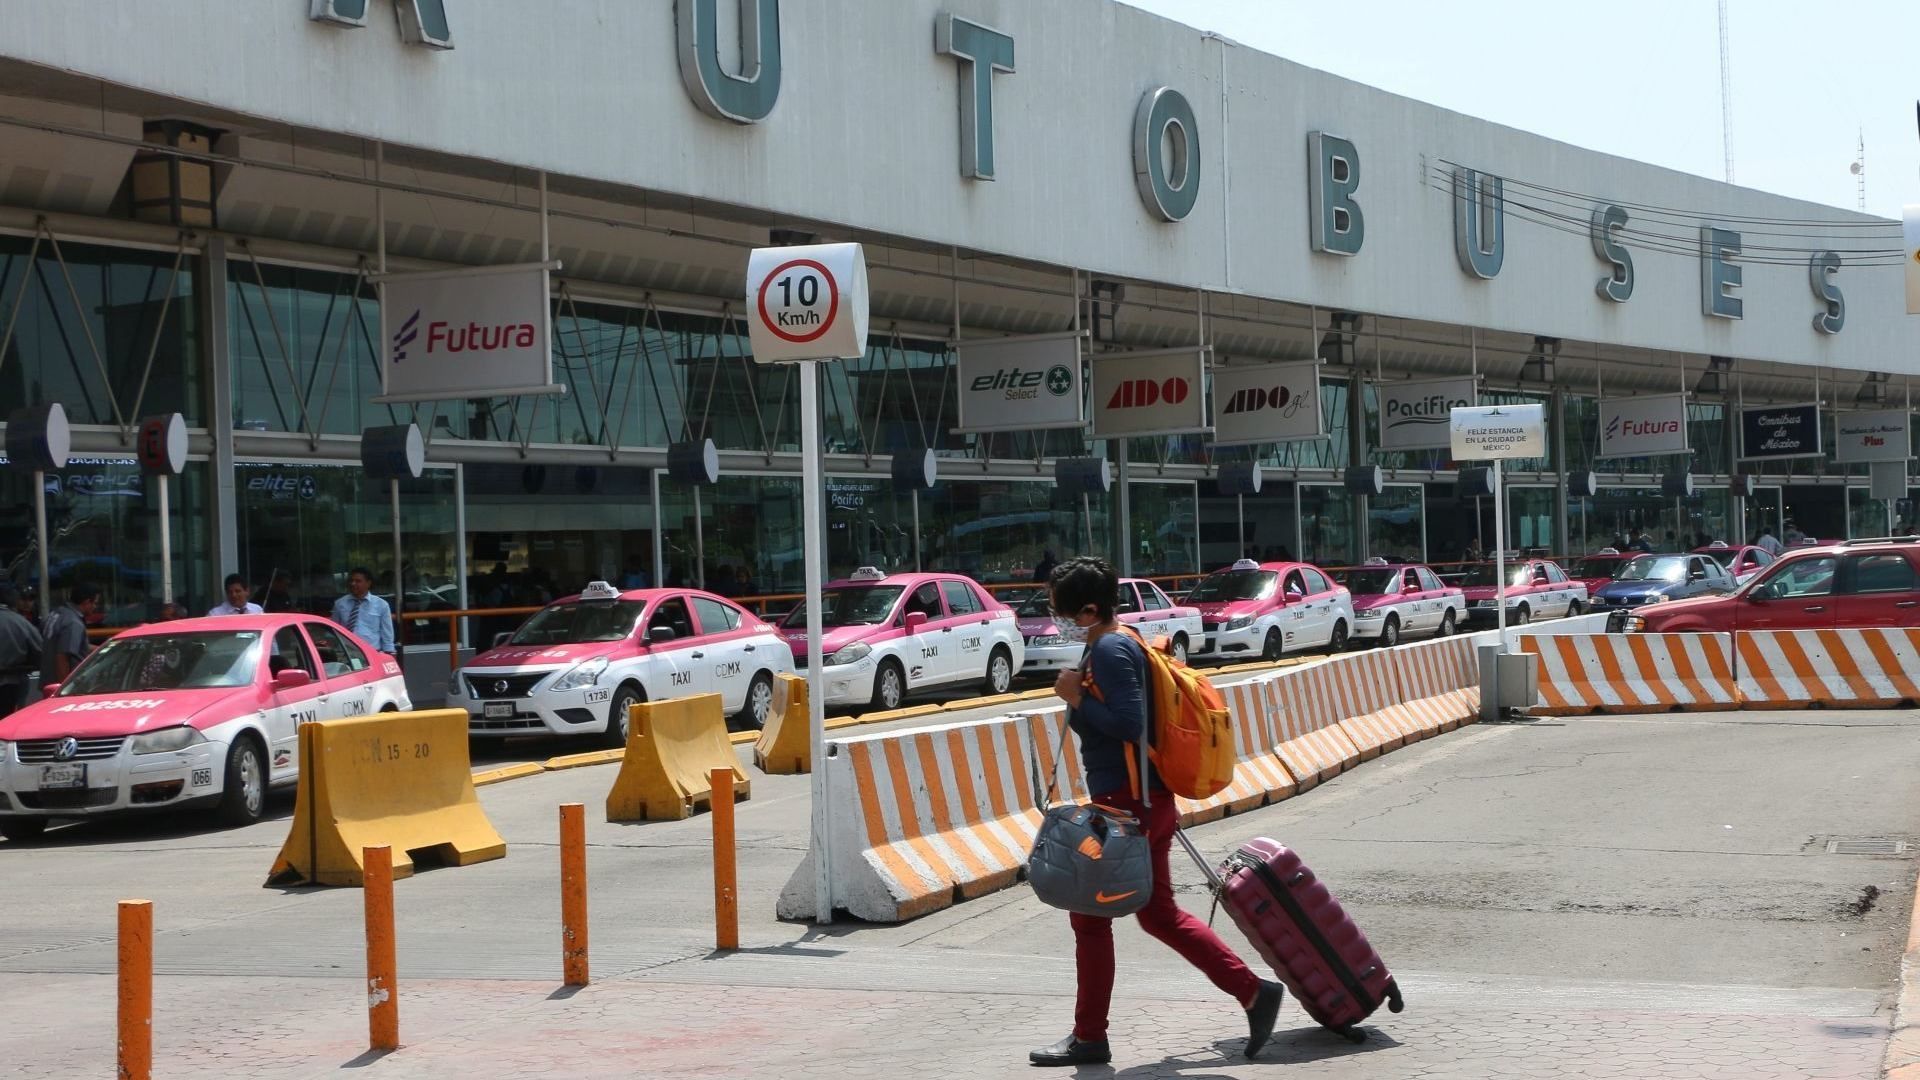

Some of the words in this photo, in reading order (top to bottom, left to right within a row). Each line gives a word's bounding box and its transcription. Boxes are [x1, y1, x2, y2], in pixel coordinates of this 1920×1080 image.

[311, 0, 1845, 335] UTOBUSES
[778, 275, 818, 307] 10
[777, 310, 820, 326] Km/h
[426, 320, 535, 354] Futura
[970, 368, 1043, 392] elite
[1005, 388, 1038, 400] Select
[1106, 376, 1189, 409] ADO
[1223, 385, 1291, 414] ADO
[1758, 413, 1801, 426] Omnibus
[1489, 427, 1524, 435] ESTANCIA
[1622, 419, 1679, 436] Futura
[1773, 426, 1787, 437] de
[1483, 443, 1511, 451] MÉXICO
[1760, 438, 1801, 449] México
[1863, 435, 1885, 447] Plus
[247, 474, 298, 490] elite
[831, 493, 864, 506] Pacifico
[859, 567, 873, 575] TAXI
[590, 584, 605, 592] TAXI
[961, 637, 981, 648] CDMX
[921, 647, 938, 659] TAXI
[715, 661, 741, 678] CDMX
[671, 671, 691, 686] TAXI
[589, 691, 608, 701] 1738
[50, 699, 166, 713] A9253H
[342, 699, 366, 718] CDMX
[387, 744, 400, 760] 15
[415, 743, 430, 758] 20
[194, 771, 210, 785] 066
